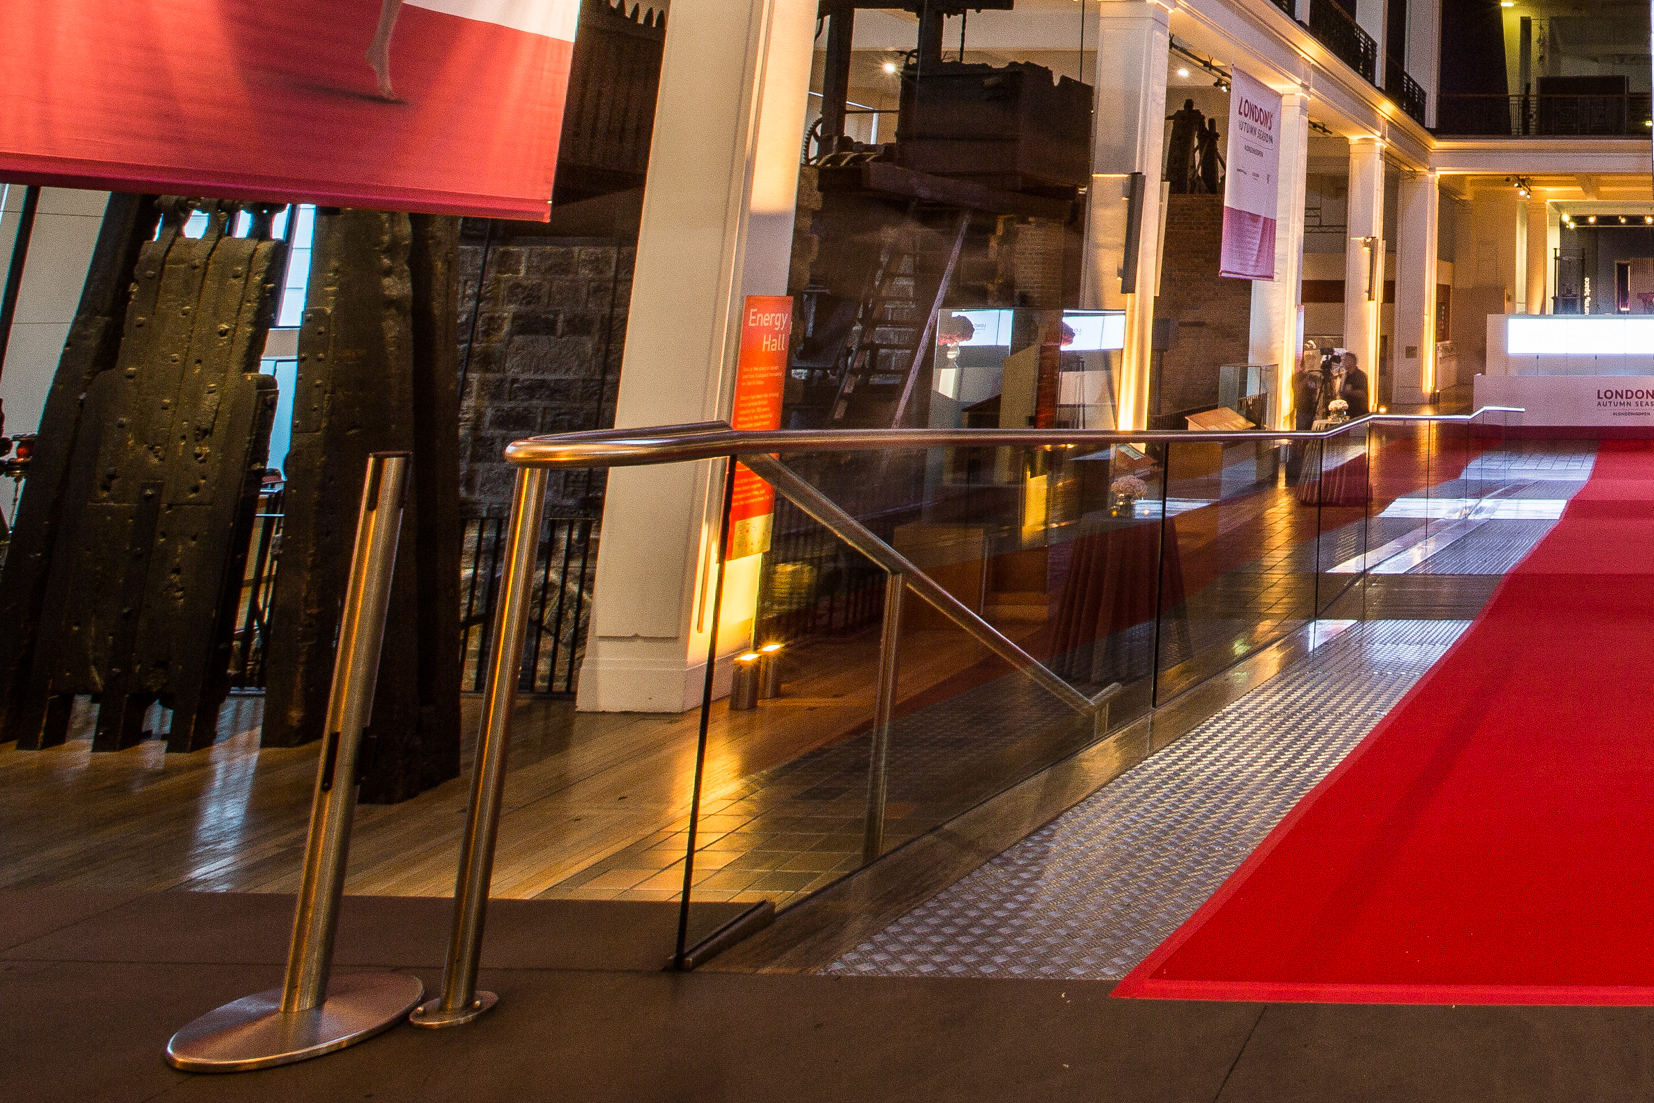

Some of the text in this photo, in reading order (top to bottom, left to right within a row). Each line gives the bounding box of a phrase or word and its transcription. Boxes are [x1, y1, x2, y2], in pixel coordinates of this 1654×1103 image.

[1238, 96, 1273, 131] LONDON'S
[1257, 128, 1274, 145] SEASON
[748, 309, 788, 330] Energy
[762, 334, 785, 352] Hall
